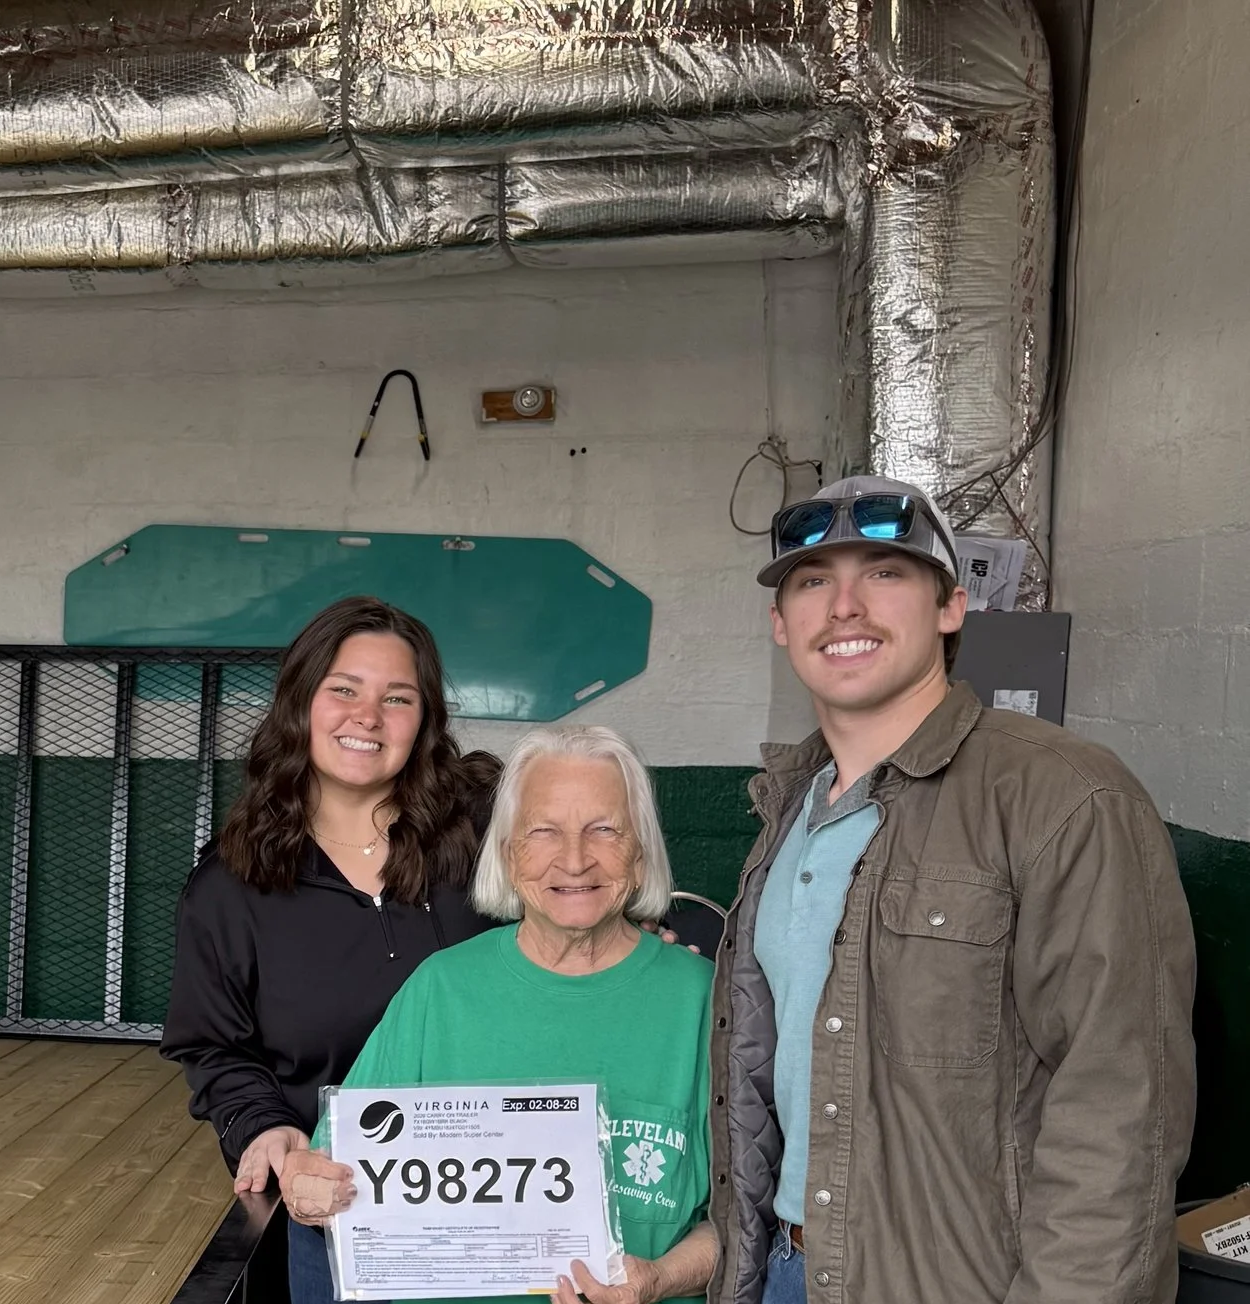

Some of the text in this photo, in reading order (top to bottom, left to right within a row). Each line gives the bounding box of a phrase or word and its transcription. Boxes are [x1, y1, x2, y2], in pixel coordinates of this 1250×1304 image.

[970, 558, 989, 577] ICP
[414, 1101, 490, 1111] VIRGINIA
[502, 1099, 578, 1112] Exp: 02-08-26
[464, 1131, 482, 1140] Super
[357, 1157, 575, 1205] Y98273
[654, 1190, 677, 1208] Crew
[1215, 1230, 1250, 1251] F1502BX
[1232, 1245, 1249, 1258] KIT
